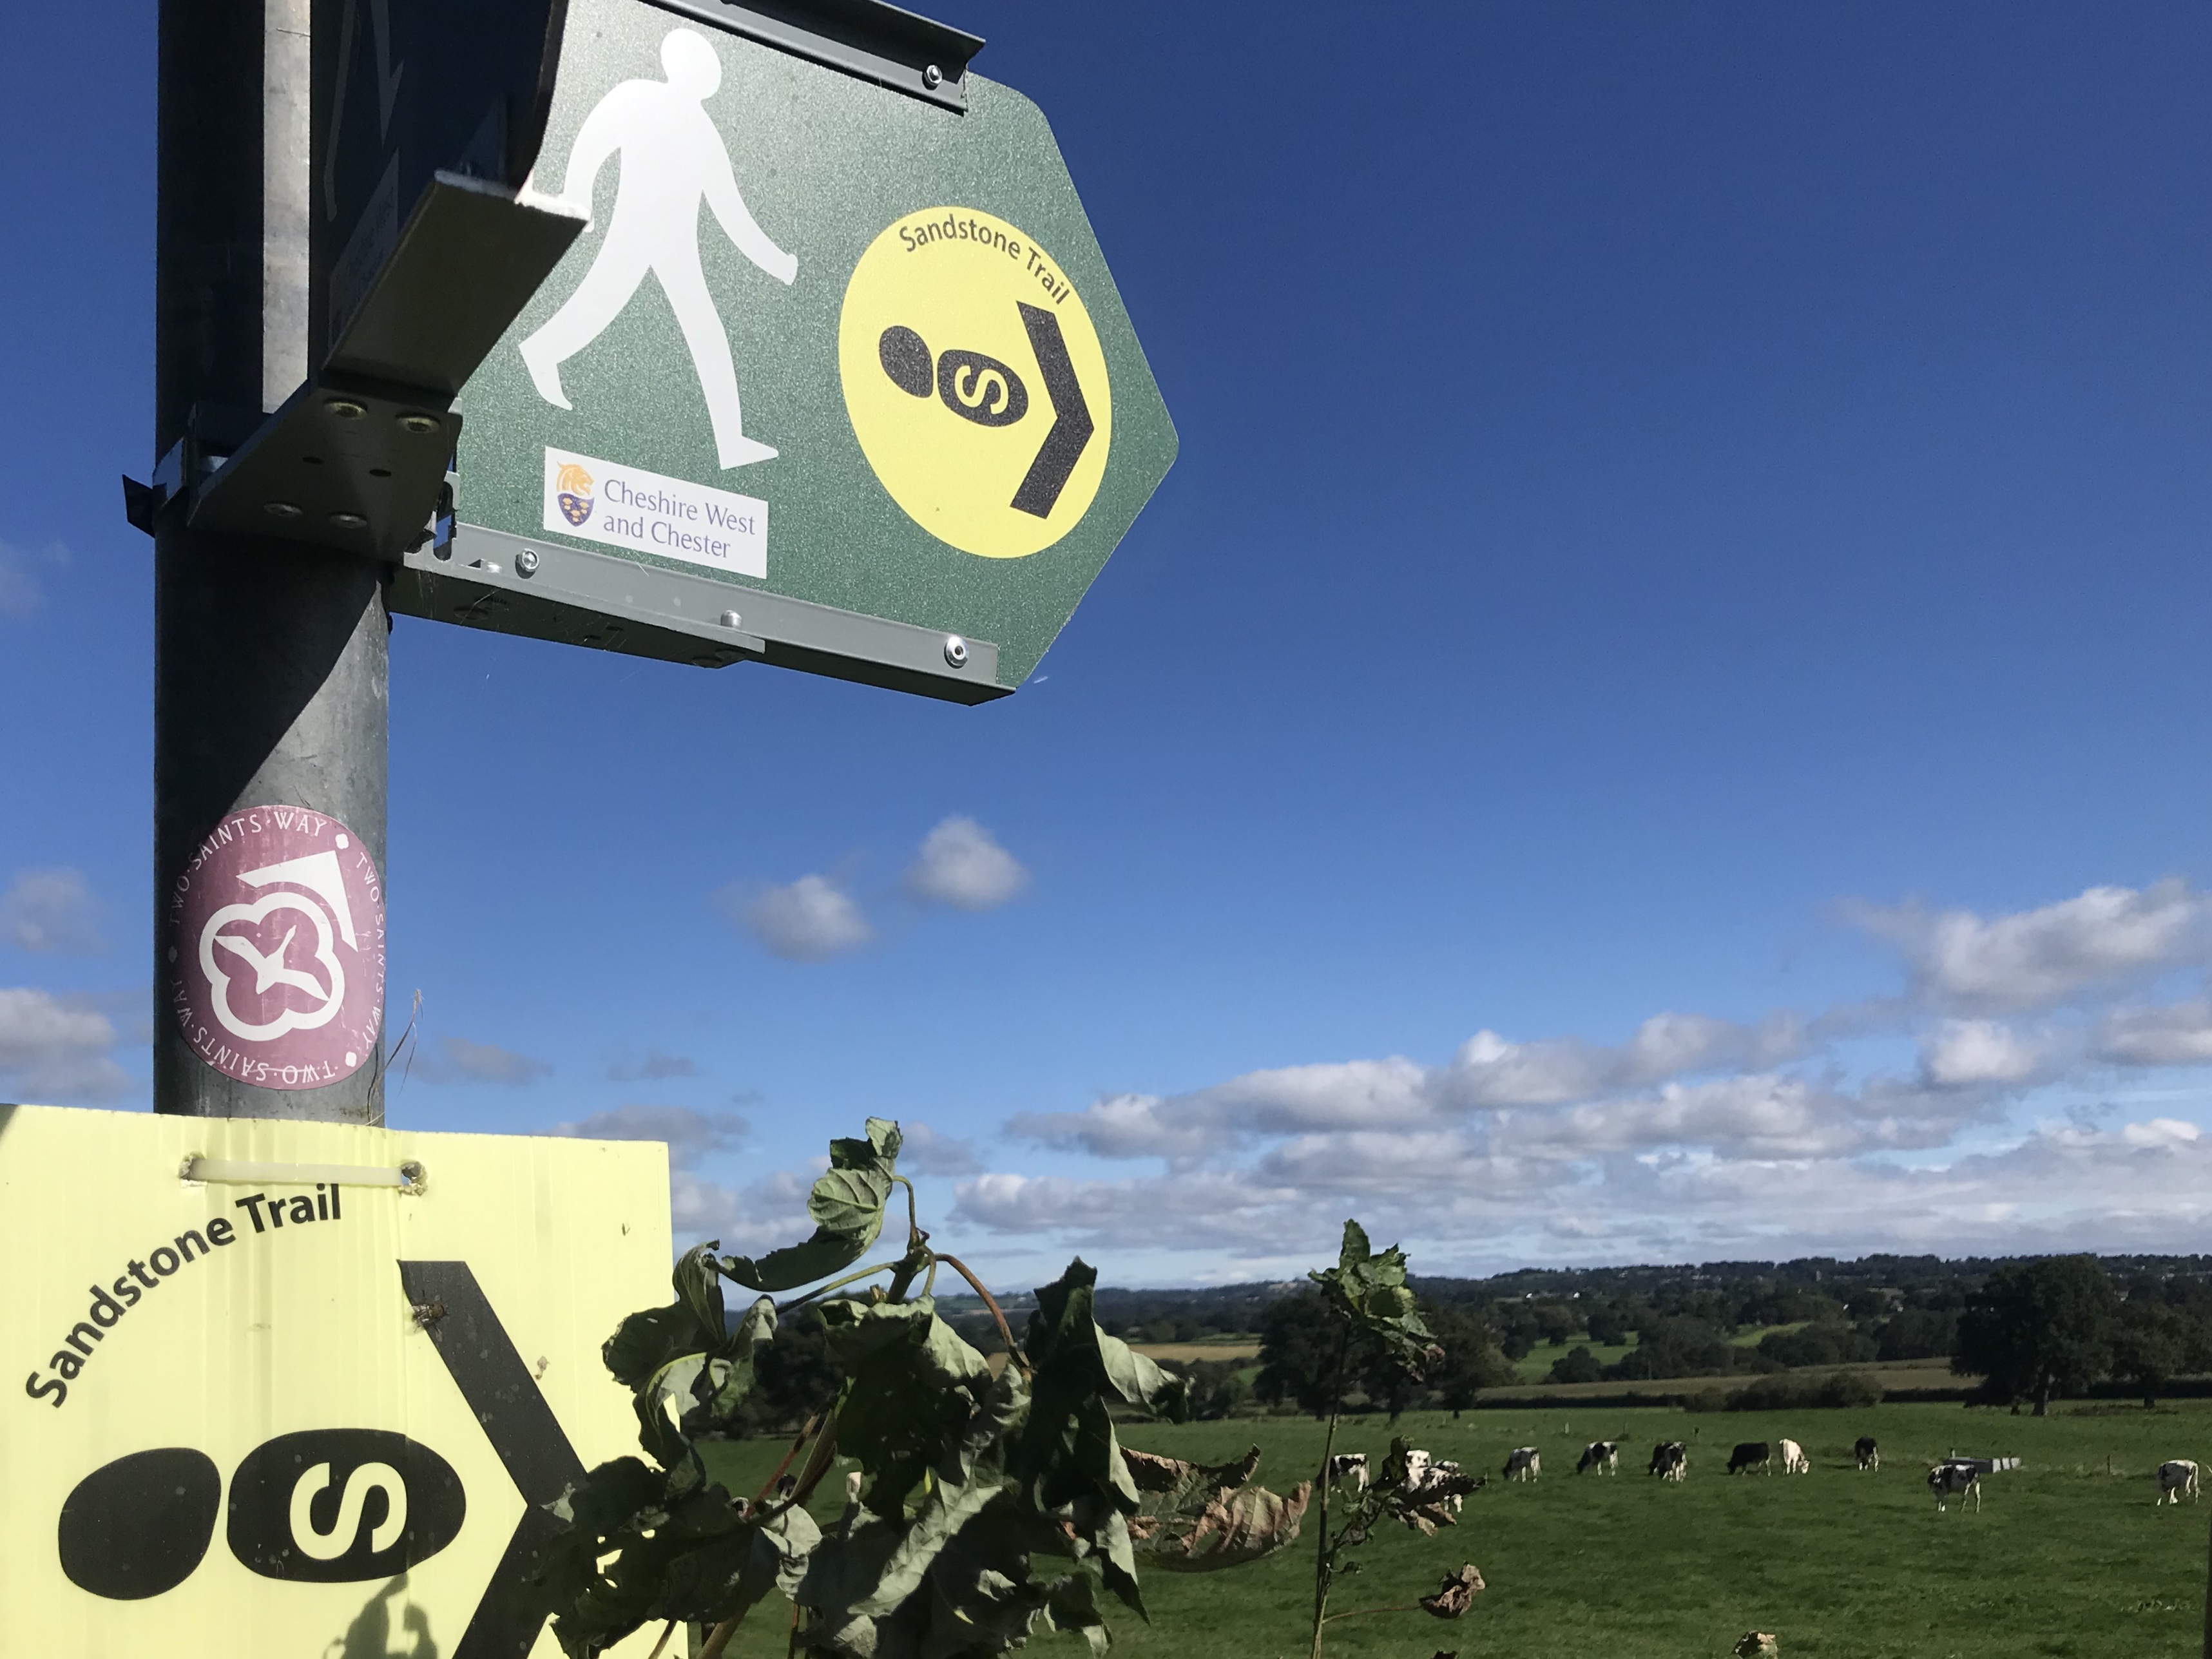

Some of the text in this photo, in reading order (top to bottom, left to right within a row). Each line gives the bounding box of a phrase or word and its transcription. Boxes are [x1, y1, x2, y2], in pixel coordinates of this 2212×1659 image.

[899, 214, 1070, 305] Sandstone Trail
[954, 365, 1009, 414] S
[604, 479, 756, 535] Cheshire West
[604, 515, 731, 559] and Chester
[188, 814, 262, 870] SAINTS
[274, 811, 327, 837] WAY
[356, 851, 380, 902] TWO
[193, 1026, 269, 1082] SAINTS
[362, 1006, 381, 1050] WAY
[282, 1060, 336, 1084] TWO
[25, 1184, 341, 1408] Sandstone Trail
[290, 1462, 407, 1560] S
